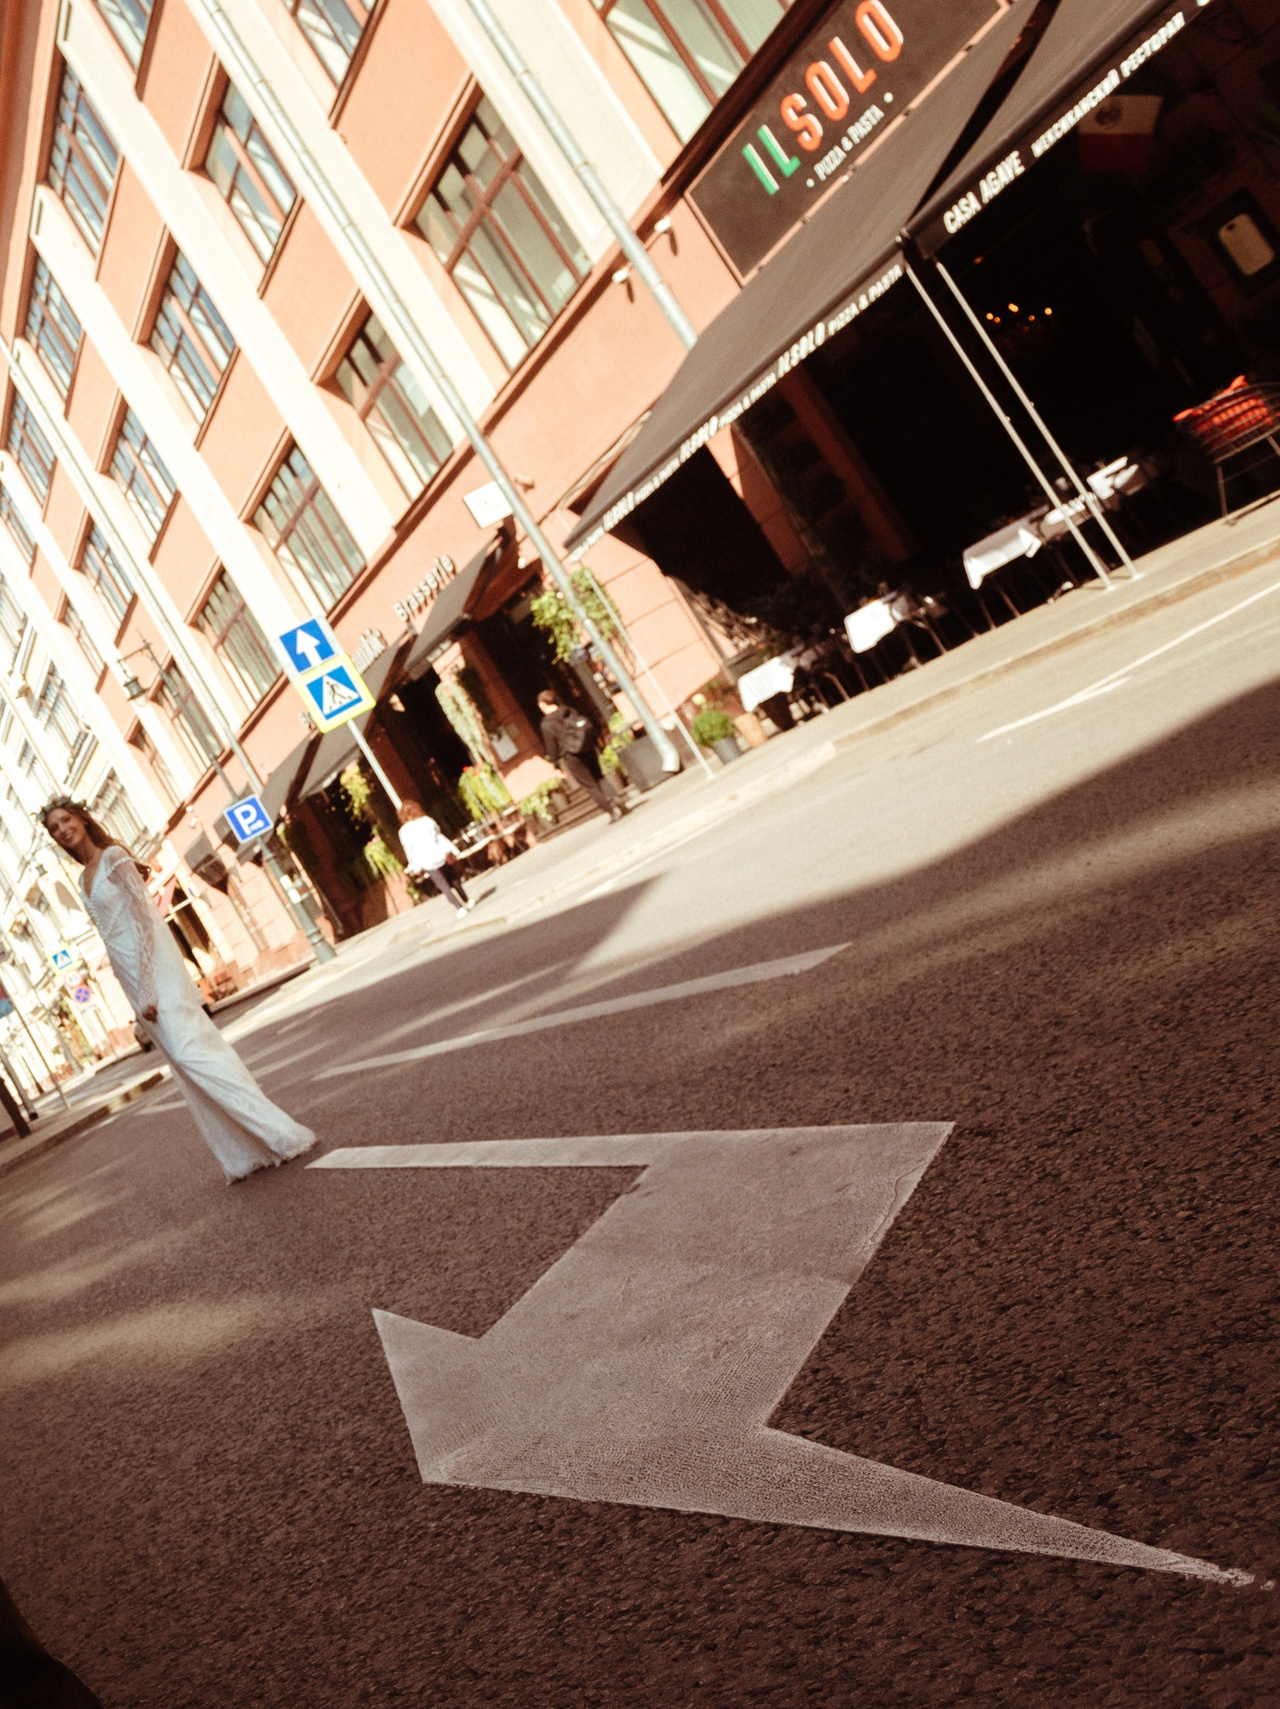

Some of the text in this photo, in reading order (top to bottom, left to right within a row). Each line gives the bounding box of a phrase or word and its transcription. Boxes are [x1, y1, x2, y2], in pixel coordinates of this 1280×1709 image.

[1031, 12, 1186, 158] МЕКСИКАНСКИЙ РЕСТОРАН
[814, 105, 885, 181] PIZZA & PASTA
[943, 191, 981, 234] CASA
[393, 554, 455, 623] Brasserie
